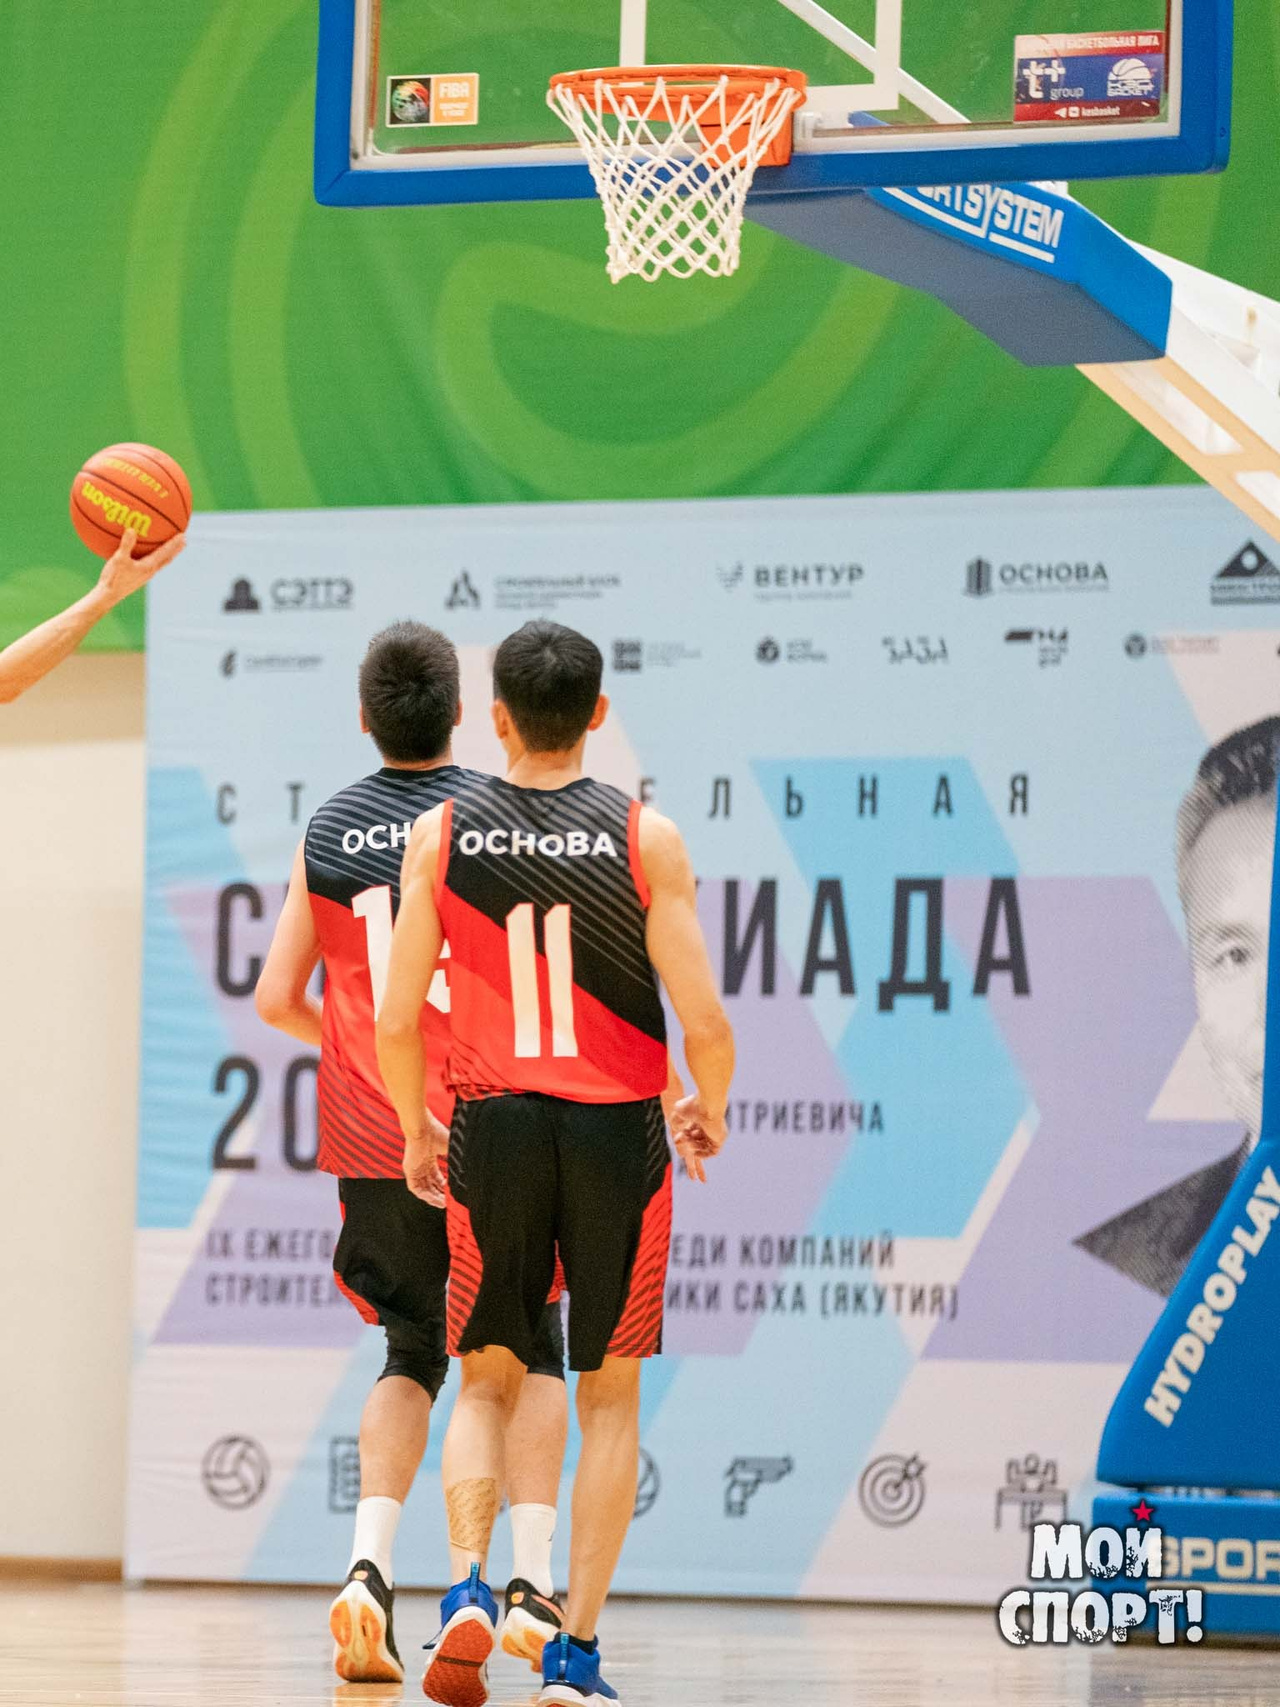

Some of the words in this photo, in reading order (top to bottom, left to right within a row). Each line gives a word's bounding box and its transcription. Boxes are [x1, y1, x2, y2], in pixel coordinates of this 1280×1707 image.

[754, 563, 864, 588] ВЕНТУР
[999, 561, 1108, 585] ОСНОВА
[342, 821, 412, 855] ОСН
[458, 829, 617, 858] ОСНОВА
[506, 902, 579, 1058] 11
[733, 1281, 807, 1313] САХА
[1144, 1165, 1280, 1428] HYDROPLAY
